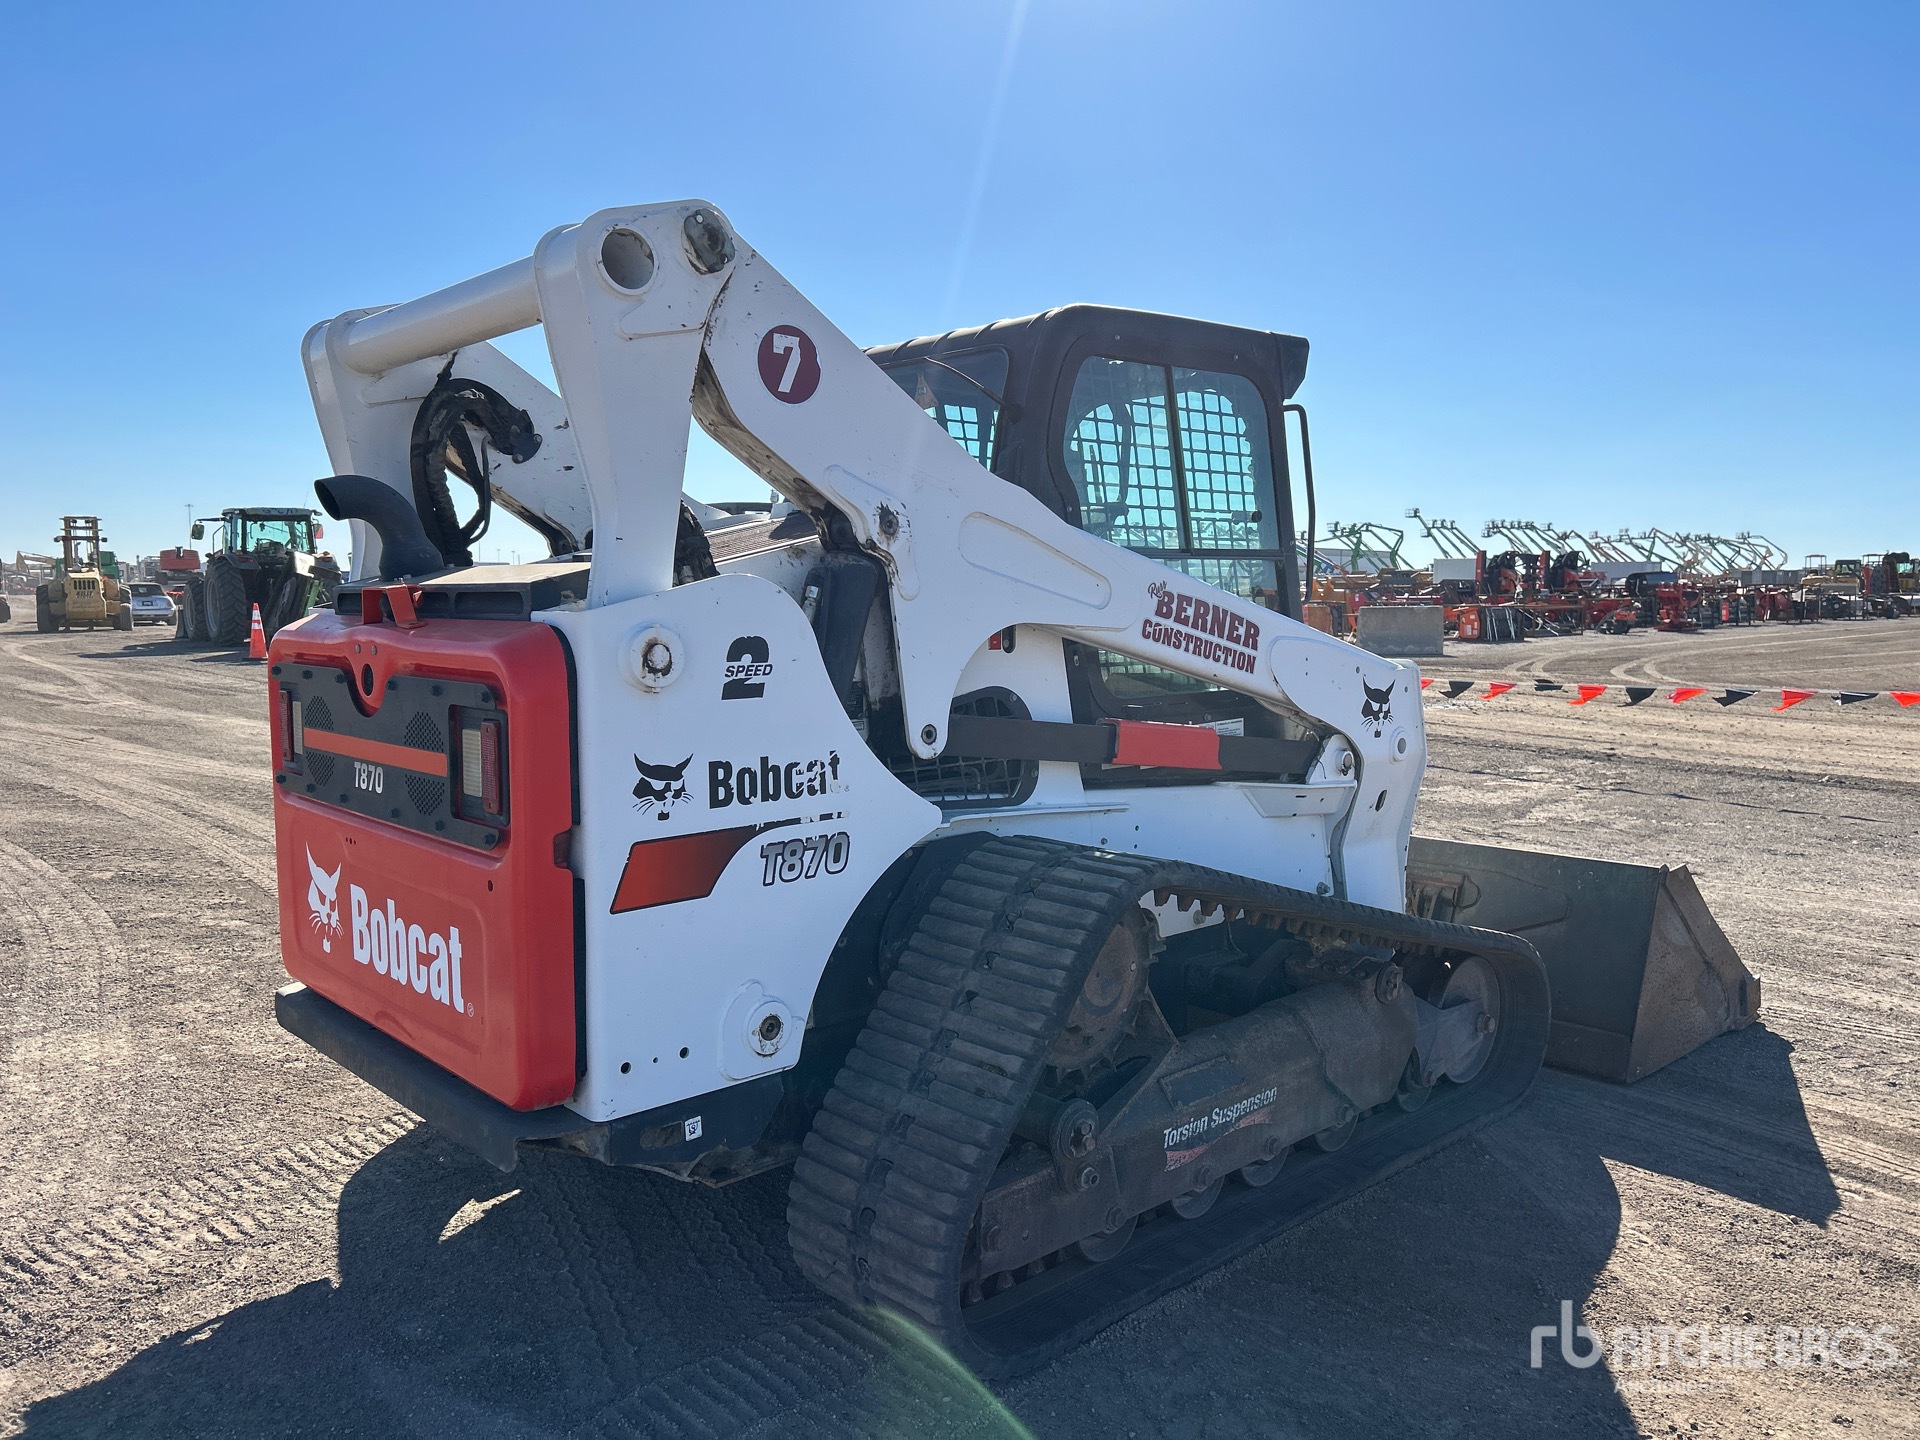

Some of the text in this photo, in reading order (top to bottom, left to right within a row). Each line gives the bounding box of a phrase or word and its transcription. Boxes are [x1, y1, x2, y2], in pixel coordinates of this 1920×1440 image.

[772, 332, 801, 394] 7
[1141, 618, 1257, 675] CONSTRUCTION
[1154, 590, 1260, 652] BERNER
[721, 635, 770, 700] 2
[724, 663, 774, 678] SPEED
[353, 761, 384, 794] T870
[708, 750, 841, 810] Bobcat
[759, 831, 851, 887] T870
[350, 883, 465, 1014] Bobcat
[1163, 1086, 1278, 1149] Torsion Suspension
